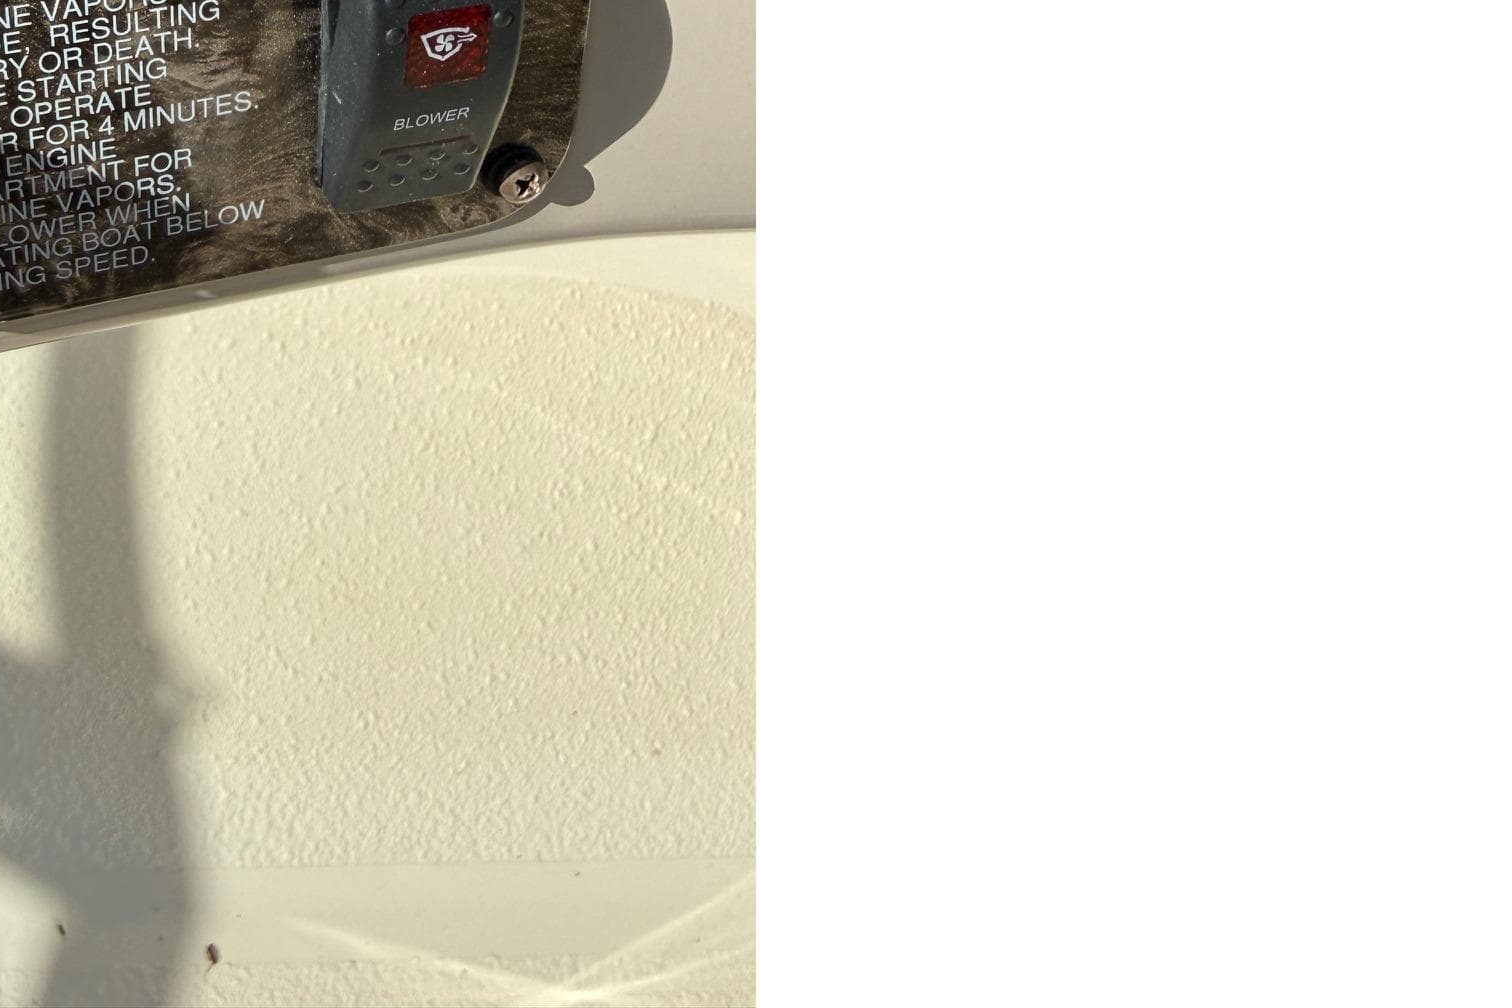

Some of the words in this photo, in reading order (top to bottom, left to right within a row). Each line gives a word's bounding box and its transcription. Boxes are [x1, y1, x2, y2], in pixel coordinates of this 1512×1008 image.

[49, 0, 221, 47] RESULTING
[38, 48, 83, 74] OR
[94, 28, 200, 62] DEATH.
[17, 58, 168, 102] STARTING
[10, 84, 152, 128] OPERATE
[29, 122, 90, 149] FOR
[98, 116, 113, 136] 4
[123, 92, 259, 132] MINUTES.
[393, 106, 470, 131] BLOWER
[7, 139, 117, 177] ENGINE
[134, 149, 192, 177] FOR
[57, 176, 181, 211] VAPORS.
[106, 193, 191, 227] WHEN
[82, 220, 157, 250] BOAT
[167, 200, 266, 236] BELOW
[56, 245, 156, 279] SPEED.
